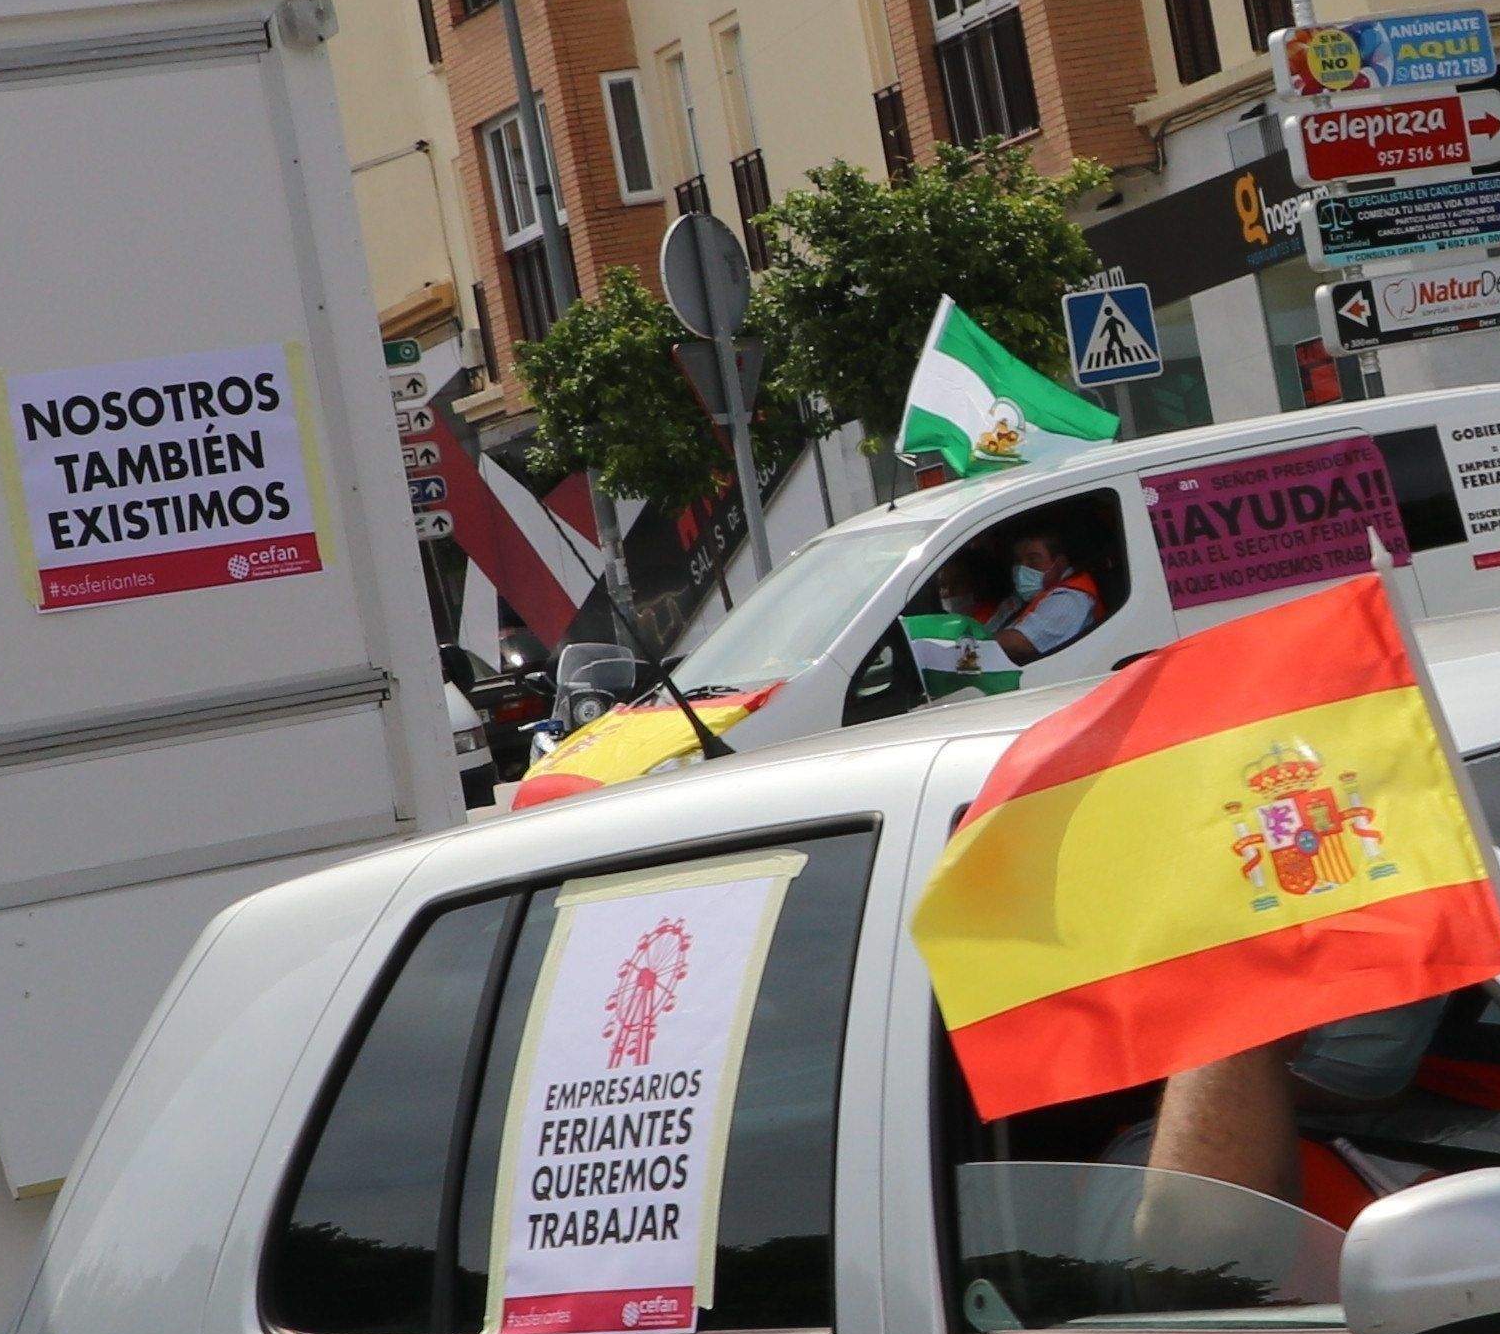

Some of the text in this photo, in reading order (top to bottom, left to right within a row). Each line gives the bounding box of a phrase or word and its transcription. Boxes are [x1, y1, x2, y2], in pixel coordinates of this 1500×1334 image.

[1389, 17, 1481, 38] ANÚNCIATE
[1321, 58, 1348, 70] NO
[1436, 61, 1460, 77] 472
[1303, 107, 1447, 149] telepizza
[1377, 142, 1464, 167] 957 516 145
[1429, 182, 1476, 198] CANCELAR
[1442, 198, 1464, 210] VIDA
[21, 372, 281, 441] NOSOTROS
[54, 423, 265, 494] TAMBIÉN
[1210, 447, 1373, 491] SEÑOR PRESIDENTE
[47, 481, 291, 550] EXISTIMOS
[50, 544, 299, 597] #sosferiantes cefan
[1161, 550, 1203, 570] ARA
[1208, 546, 1230, 563] EL
[1234, 531, 1310, 559] SECTOR
[1184, 573, 1218, 595] QUE
[1220, 569, 1245, 588] NO
[1250, 556, 1325, 584] PODEMOS
[544, 1069, 701, 1112] EMPRESARIOS
[538, 1105, 695, 1157] FERIANTES
[531, 1154, 688, 1202] QUEREMOS
[527, 1203, 681, 1250] TRABAJAR
[639, 1295, 679, 1315] cefan
